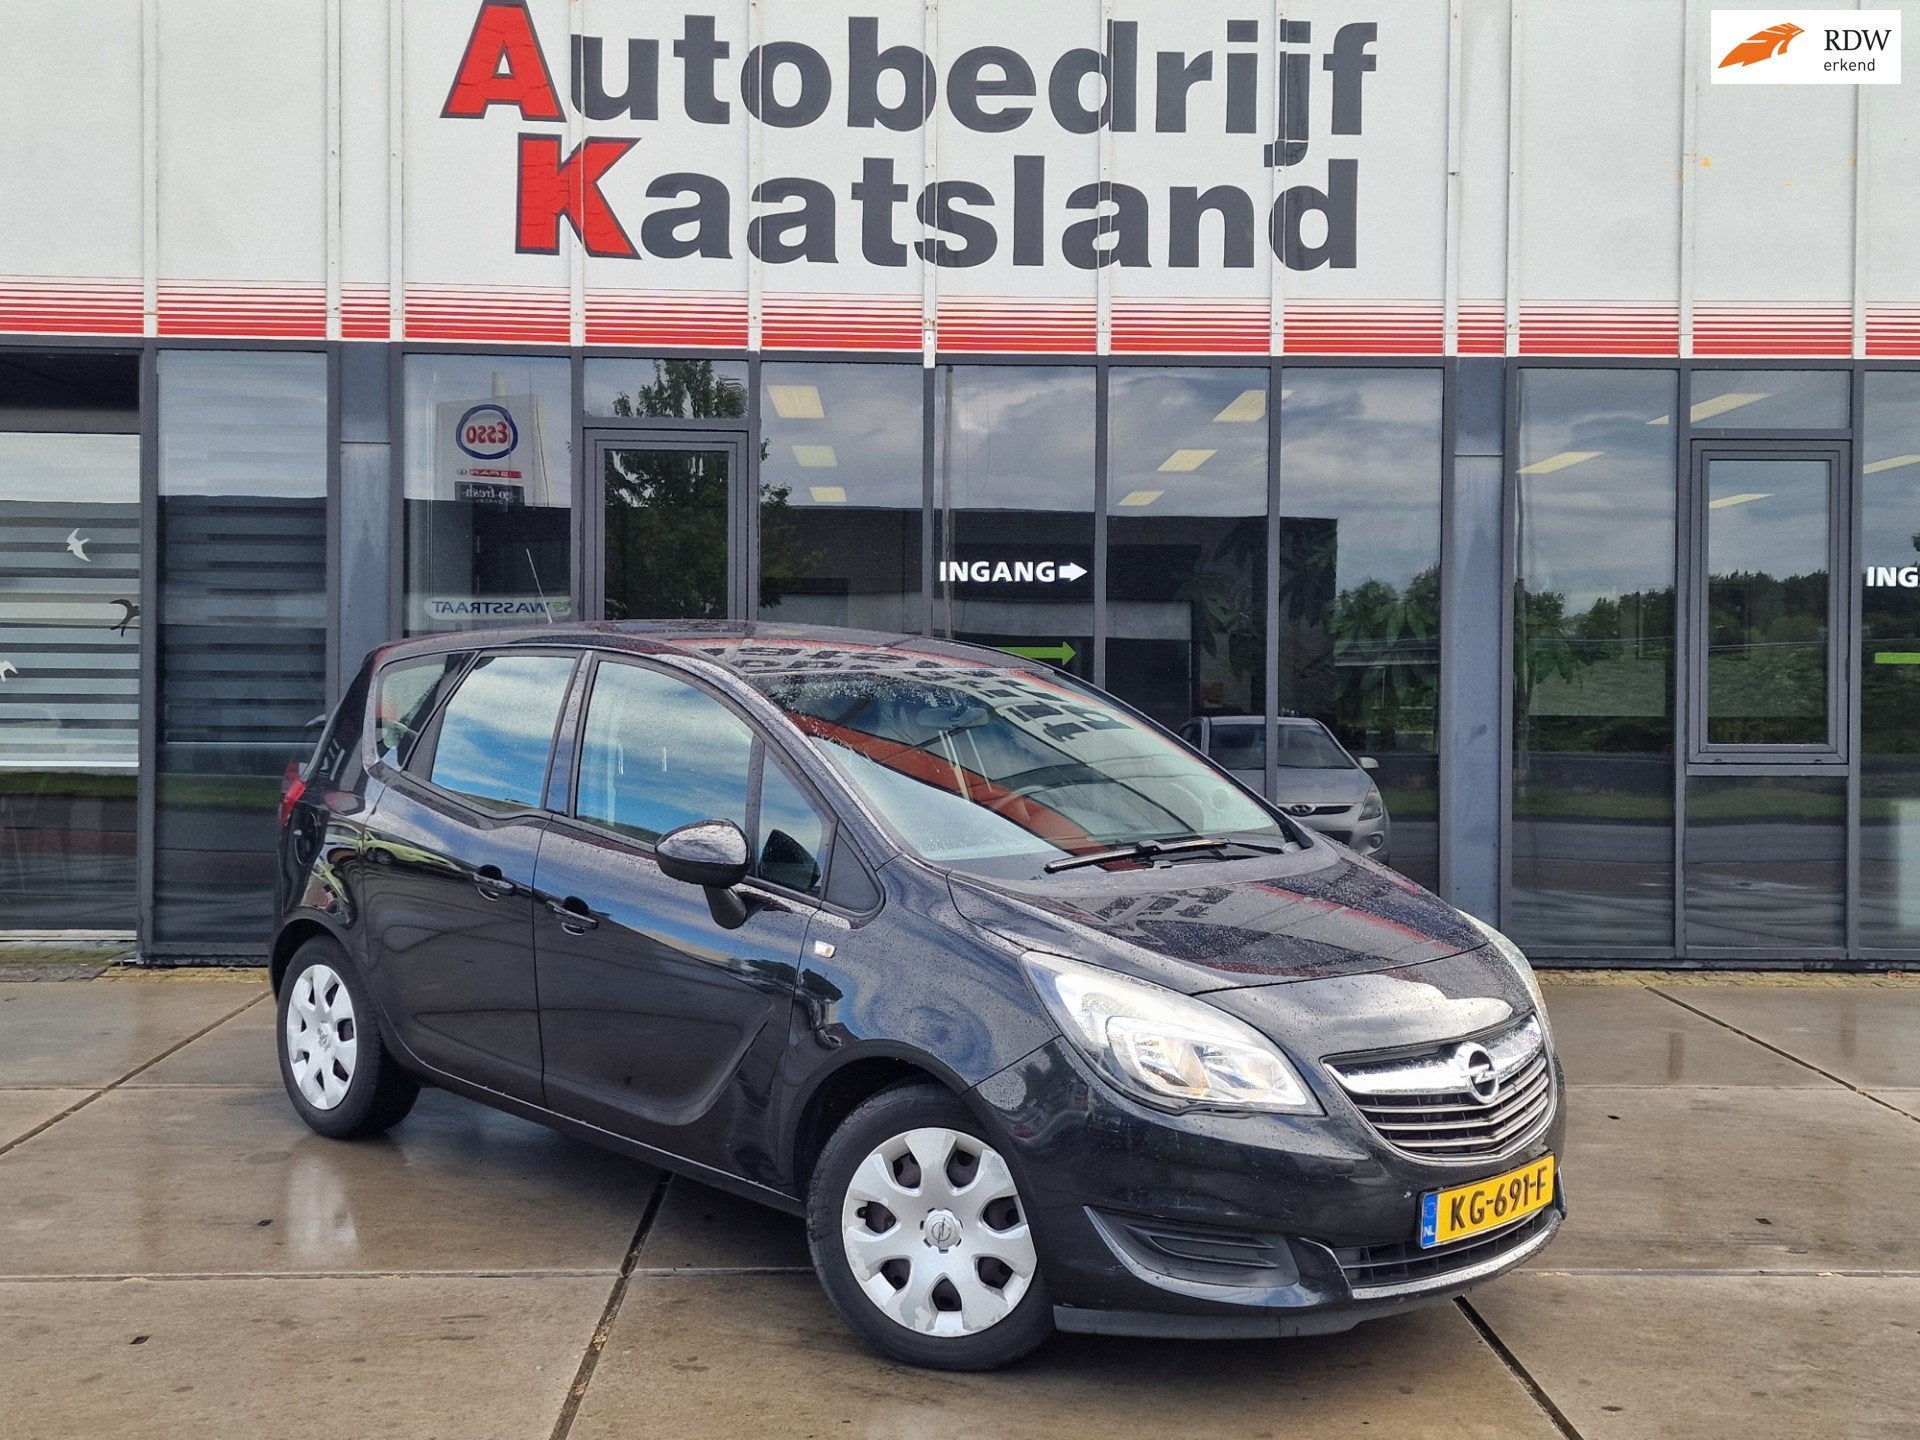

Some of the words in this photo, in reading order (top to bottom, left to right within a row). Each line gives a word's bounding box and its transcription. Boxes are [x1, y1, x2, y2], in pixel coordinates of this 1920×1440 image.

[440, 0, 1378, 167] Autobedrijf
[515, 133, 1358, 271] Kaatsland
[939, 561, 1056, 582] INGANG
[1866, 566, 1920, 588] ING
[1450, 1166, 1548, 1232] KG-691-F
[1423, 1225, 1435, 1237] NL
